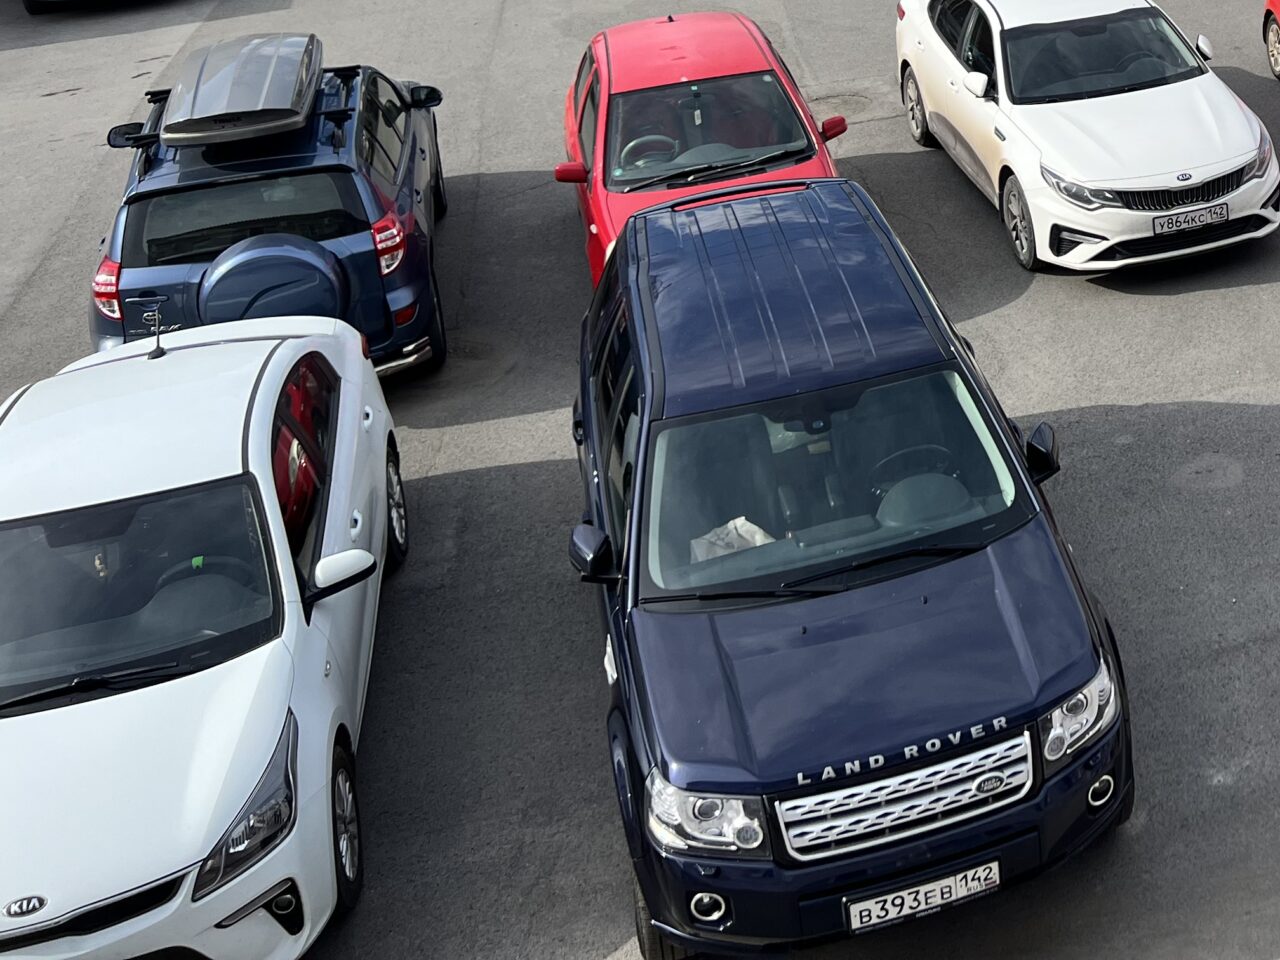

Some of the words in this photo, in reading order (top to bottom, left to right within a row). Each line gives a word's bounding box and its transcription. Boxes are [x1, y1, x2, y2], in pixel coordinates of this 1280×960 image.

[1159, 214, 1206, 231] У864КС
[1207, 206, 1225, 221] 142
[796, 753, 886, 786] LAND
[903, 715, 1009, 760] ROVER
[10, 897, 41, 915] KIA
[859, 884, 953, 925] В393ЕВ
[959, 865, 994, 888] 142
